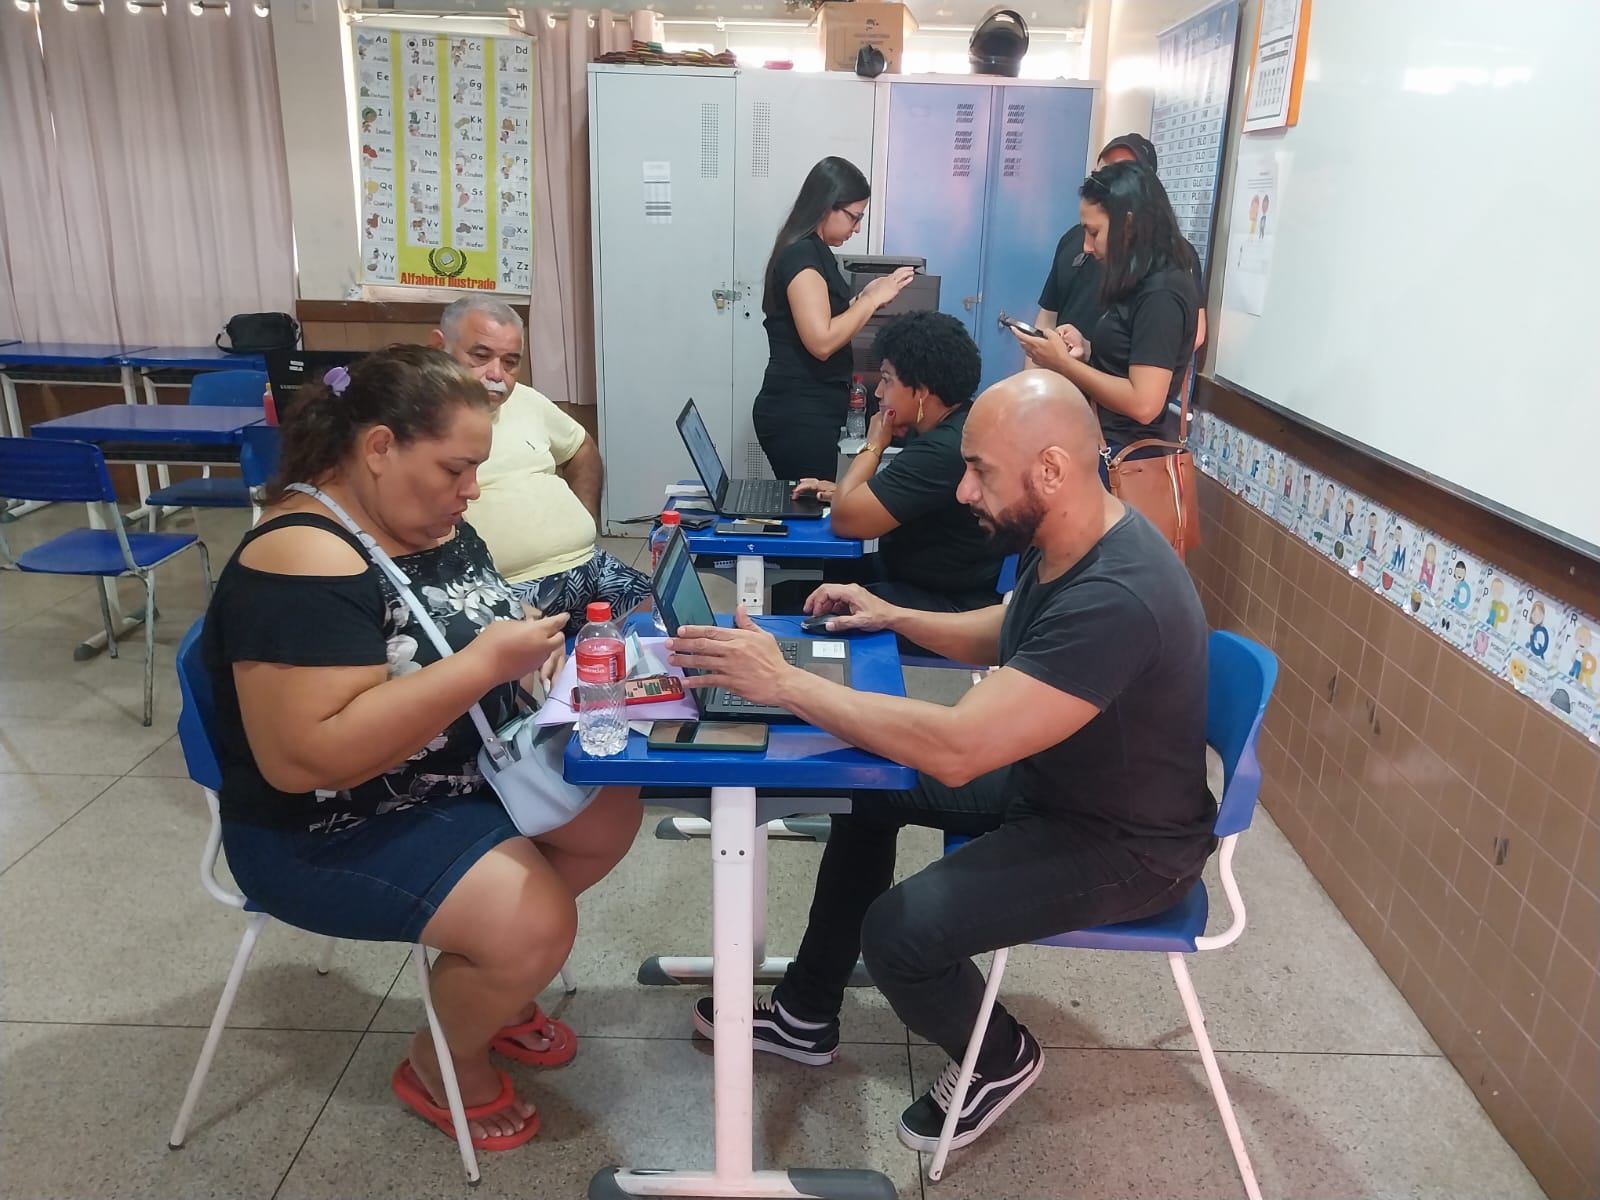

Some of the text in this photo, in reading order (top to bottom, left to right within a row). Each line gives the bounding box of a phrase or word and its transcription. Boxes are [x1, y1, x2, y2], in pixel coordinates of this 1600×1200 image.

[400, 271, 445, 287] Alfabeto
[447, 275, 496, 290] Ilustrado
[1393, 544, 1407, 572] M
[1526, 589, 1534, 602] Q
[1493, 601, 1509, 630] P
[1569, 612, 1578, 626] R
[1530, 623, 1550, 660] Q
